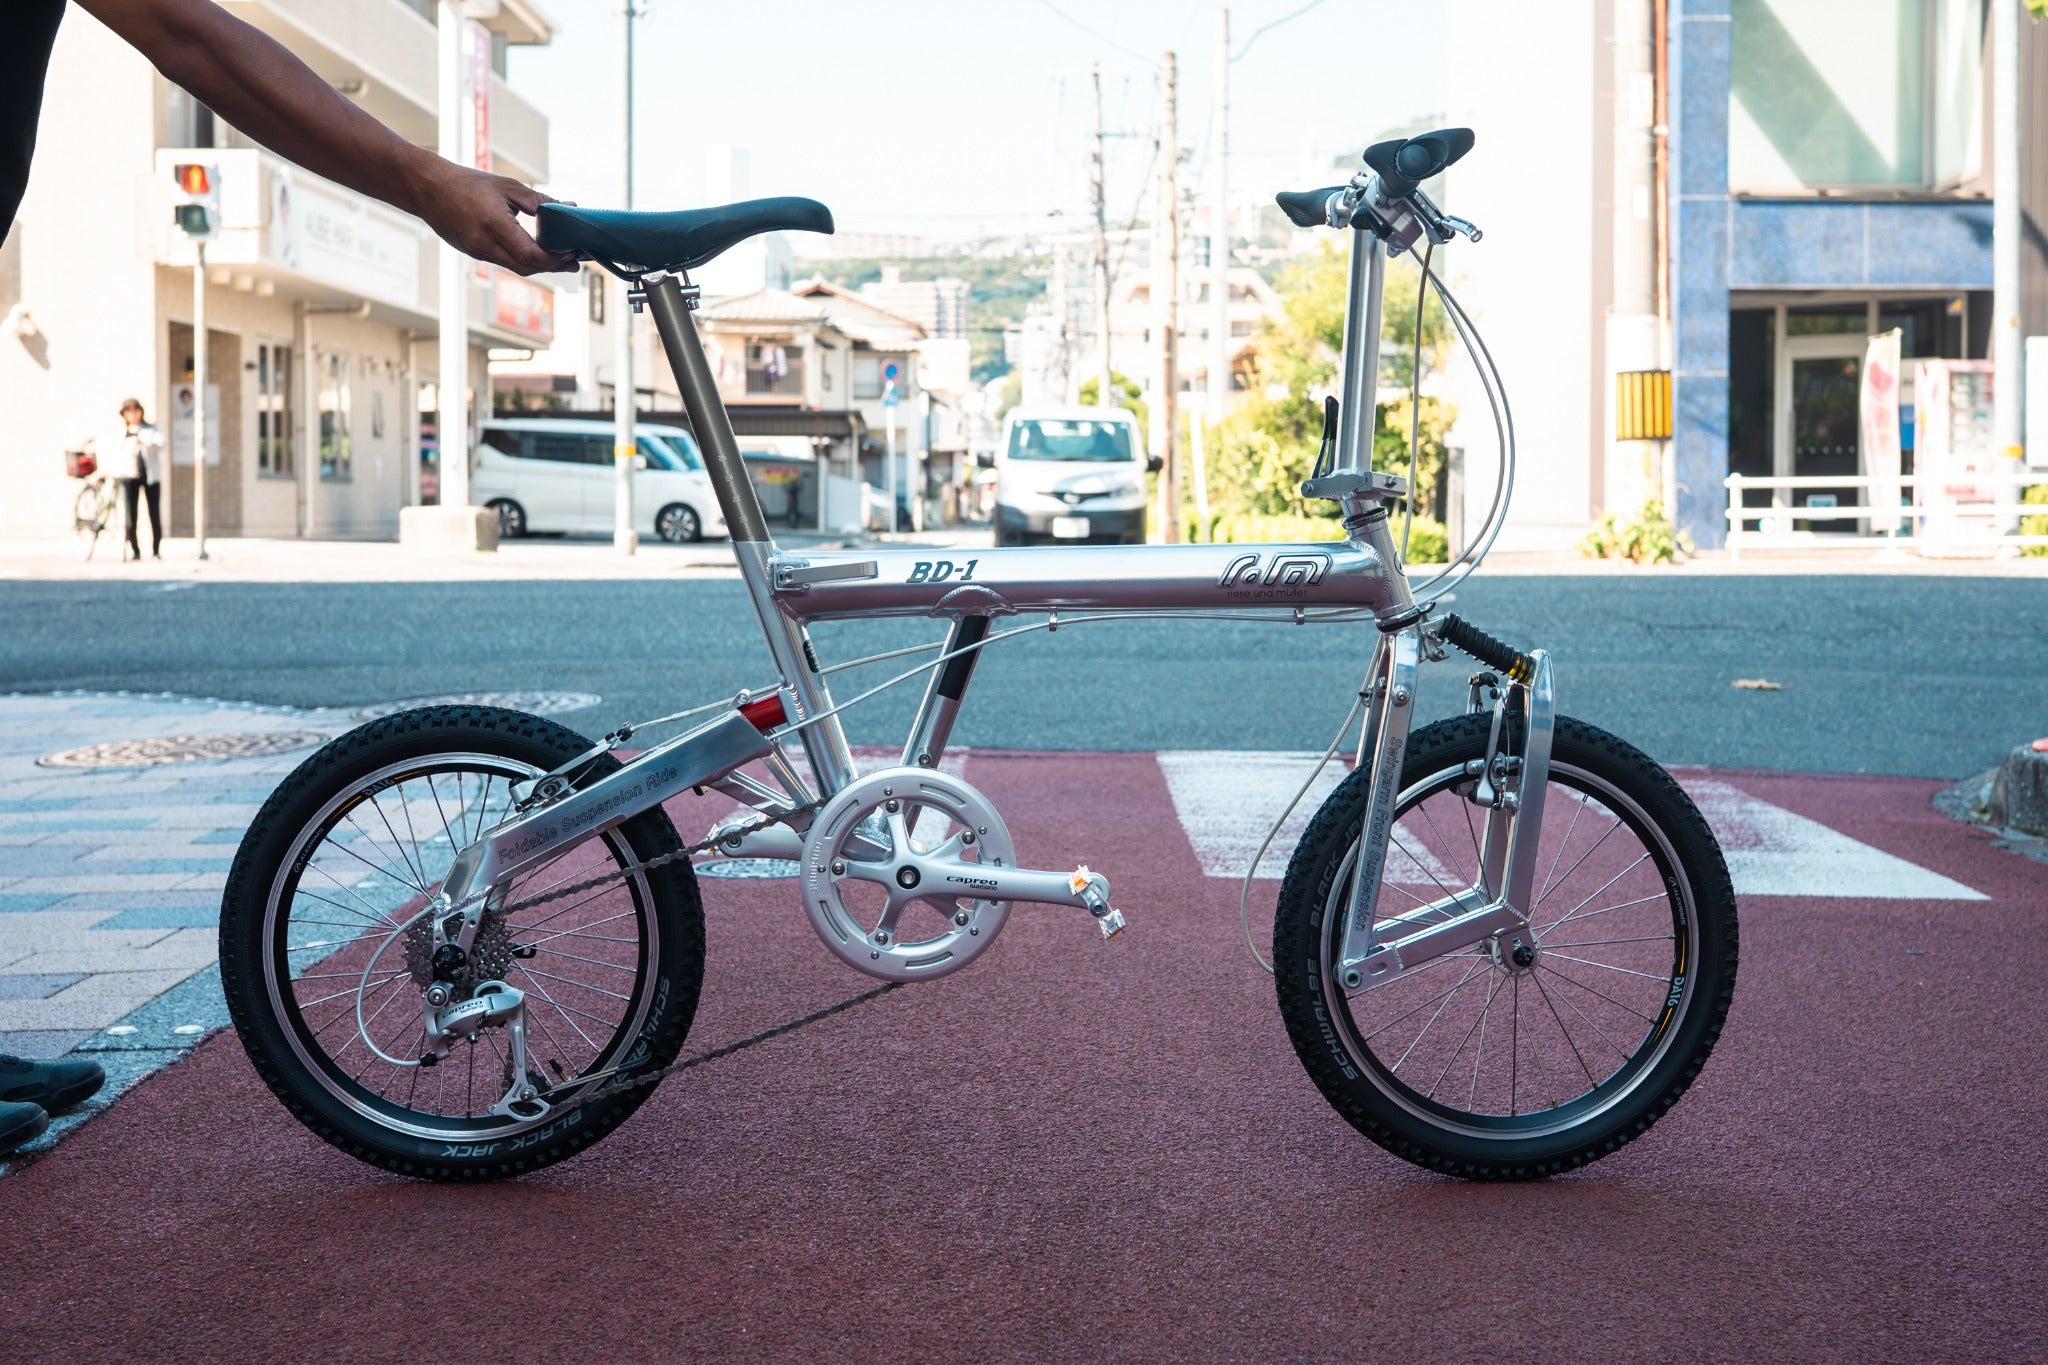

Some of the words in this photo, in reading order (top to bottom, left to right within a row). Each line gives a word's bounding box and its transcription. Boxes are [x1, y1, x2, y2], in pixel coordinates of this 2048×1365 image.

[906, 560, 979, 583] BD-1
[1253, 588, 1274, 598] und
[1380, 736, 1403, 806] Swingarm
[499, 827, 558, 864] Foldable
[561, 784, 643, 832] Suspension
[646, 767, 677, 790] Ride
[1371, 810, 1390, 847] Front
[946, 876, 998, 885] capreo
[1310, 850, 1341, 928] BLACK
[1355, 849, 1381, 932] Suspension
[1667, 976, 1685, 1007] DA16
[1307, 958, 1359, 1080] SCHWALBE
[510, 1109, 582, 1150] BLACK
[441, 1142, 502, 1157] JACK
